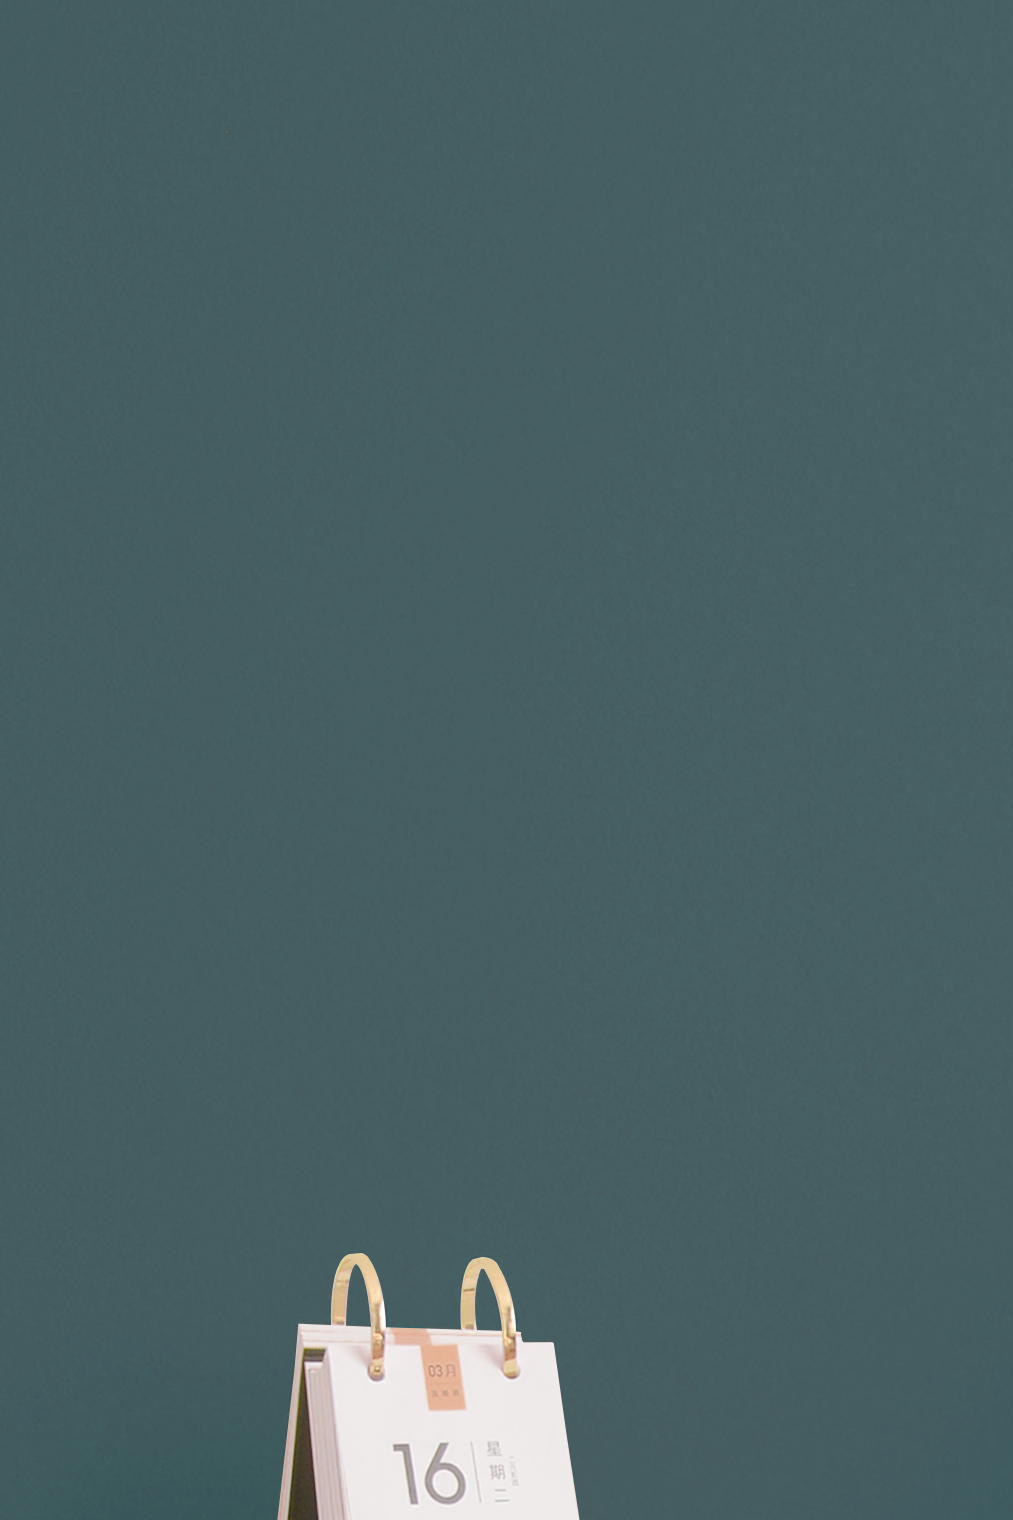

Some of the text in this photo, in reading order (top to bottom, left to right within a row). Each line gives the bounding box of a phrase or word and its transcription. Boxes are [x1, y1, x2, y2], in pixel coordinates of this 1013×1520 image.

[427, 1363, 457, 1379] 03月
[392, 1441, 467, 1506] 16
[486, 1440, 511, 1503] 星期二
